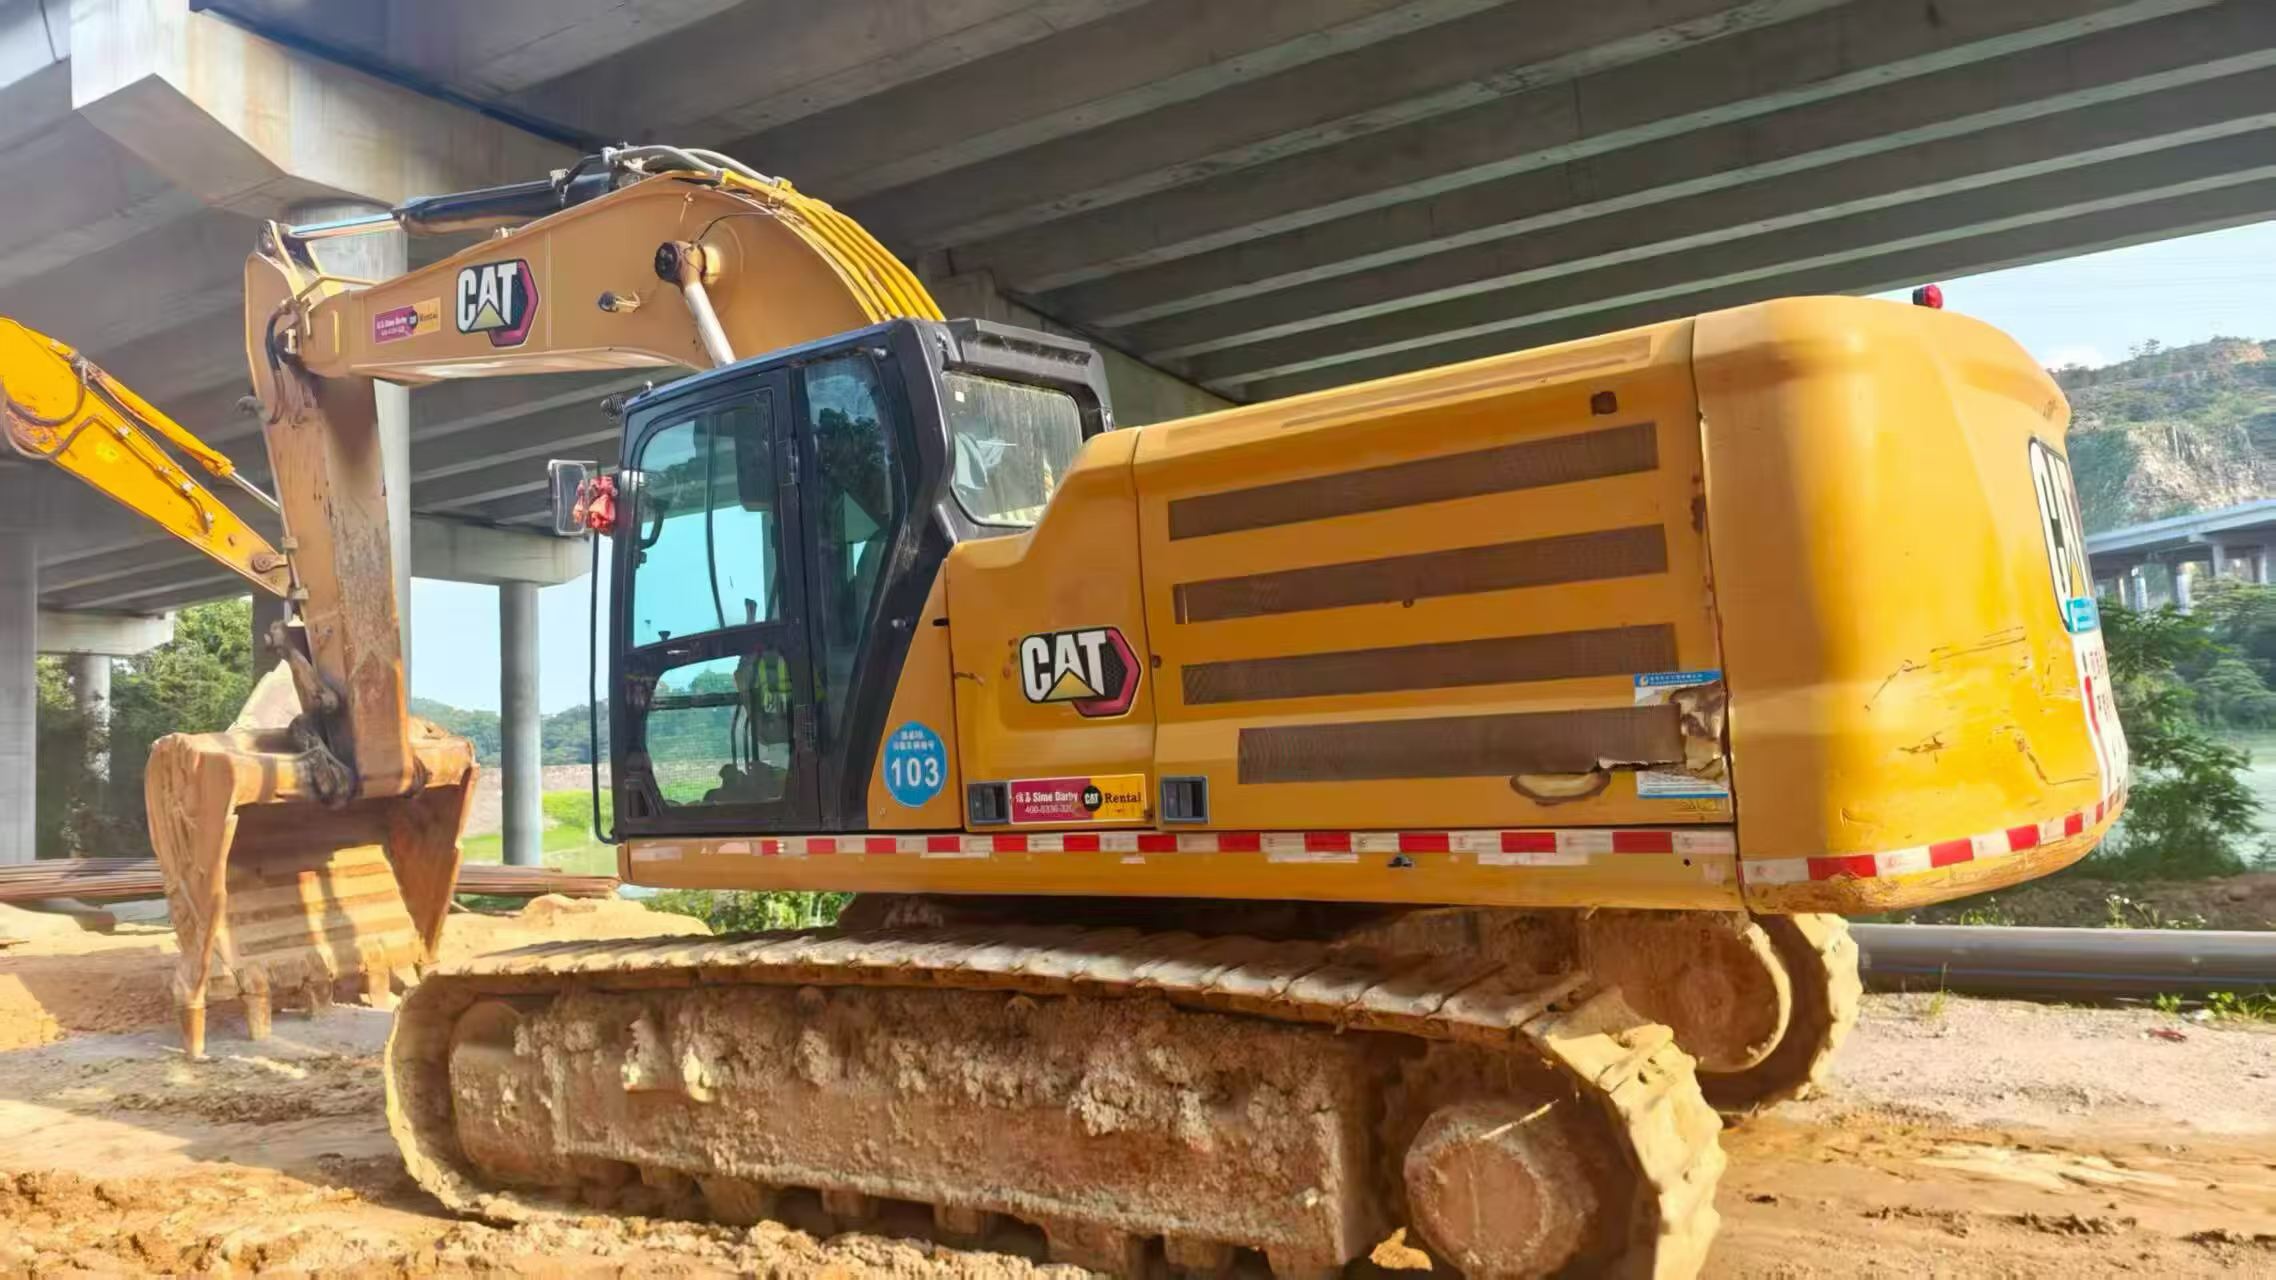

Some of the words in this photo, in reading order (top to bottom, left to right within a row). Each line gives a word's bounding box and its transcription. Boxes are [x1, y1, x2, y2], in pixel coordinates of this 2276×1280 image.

[457, 262, 518, 332] CAT
[1021, 630, 1107, 701] CAT
[891, 757, 940, 787] 103
[1032, 791, 1053, 803] Sime
[1055, 791, 1079, 803] Darby
[1084, 792, 1100, 805] CAT
[1104, 791, 1142, 804] Rental
